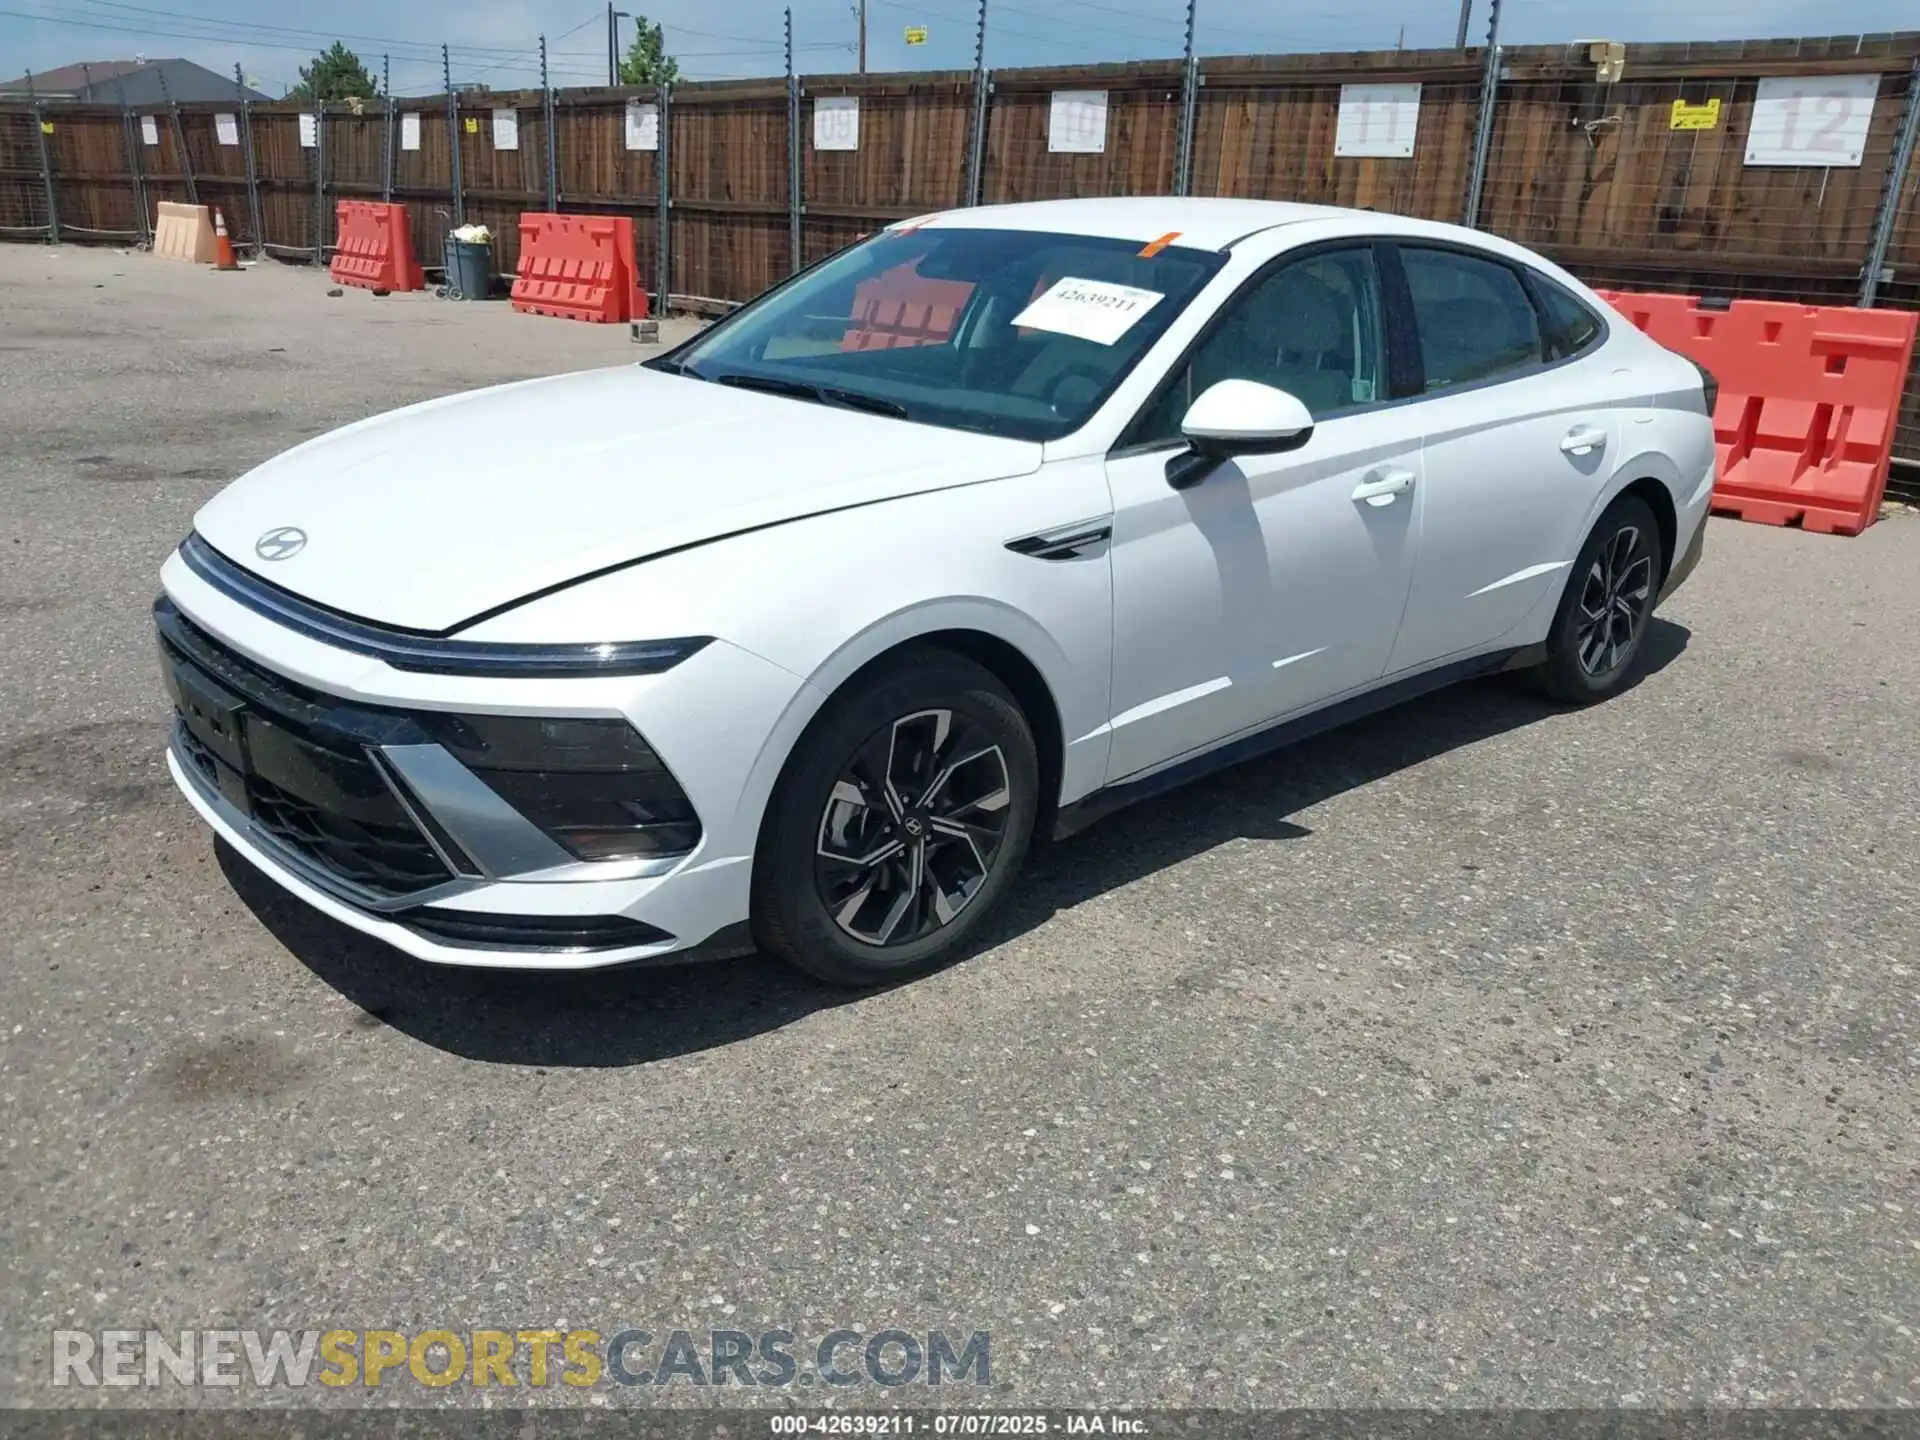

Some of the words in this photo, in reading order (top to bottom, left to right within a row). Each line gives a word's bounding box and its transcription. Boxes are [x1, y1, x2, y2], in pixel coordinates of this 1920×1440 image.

[1354, 94, 1400, 144] 11
[1777, 90, 1852, 151] 12
[1057, 289, 1137, 312] 42639211
